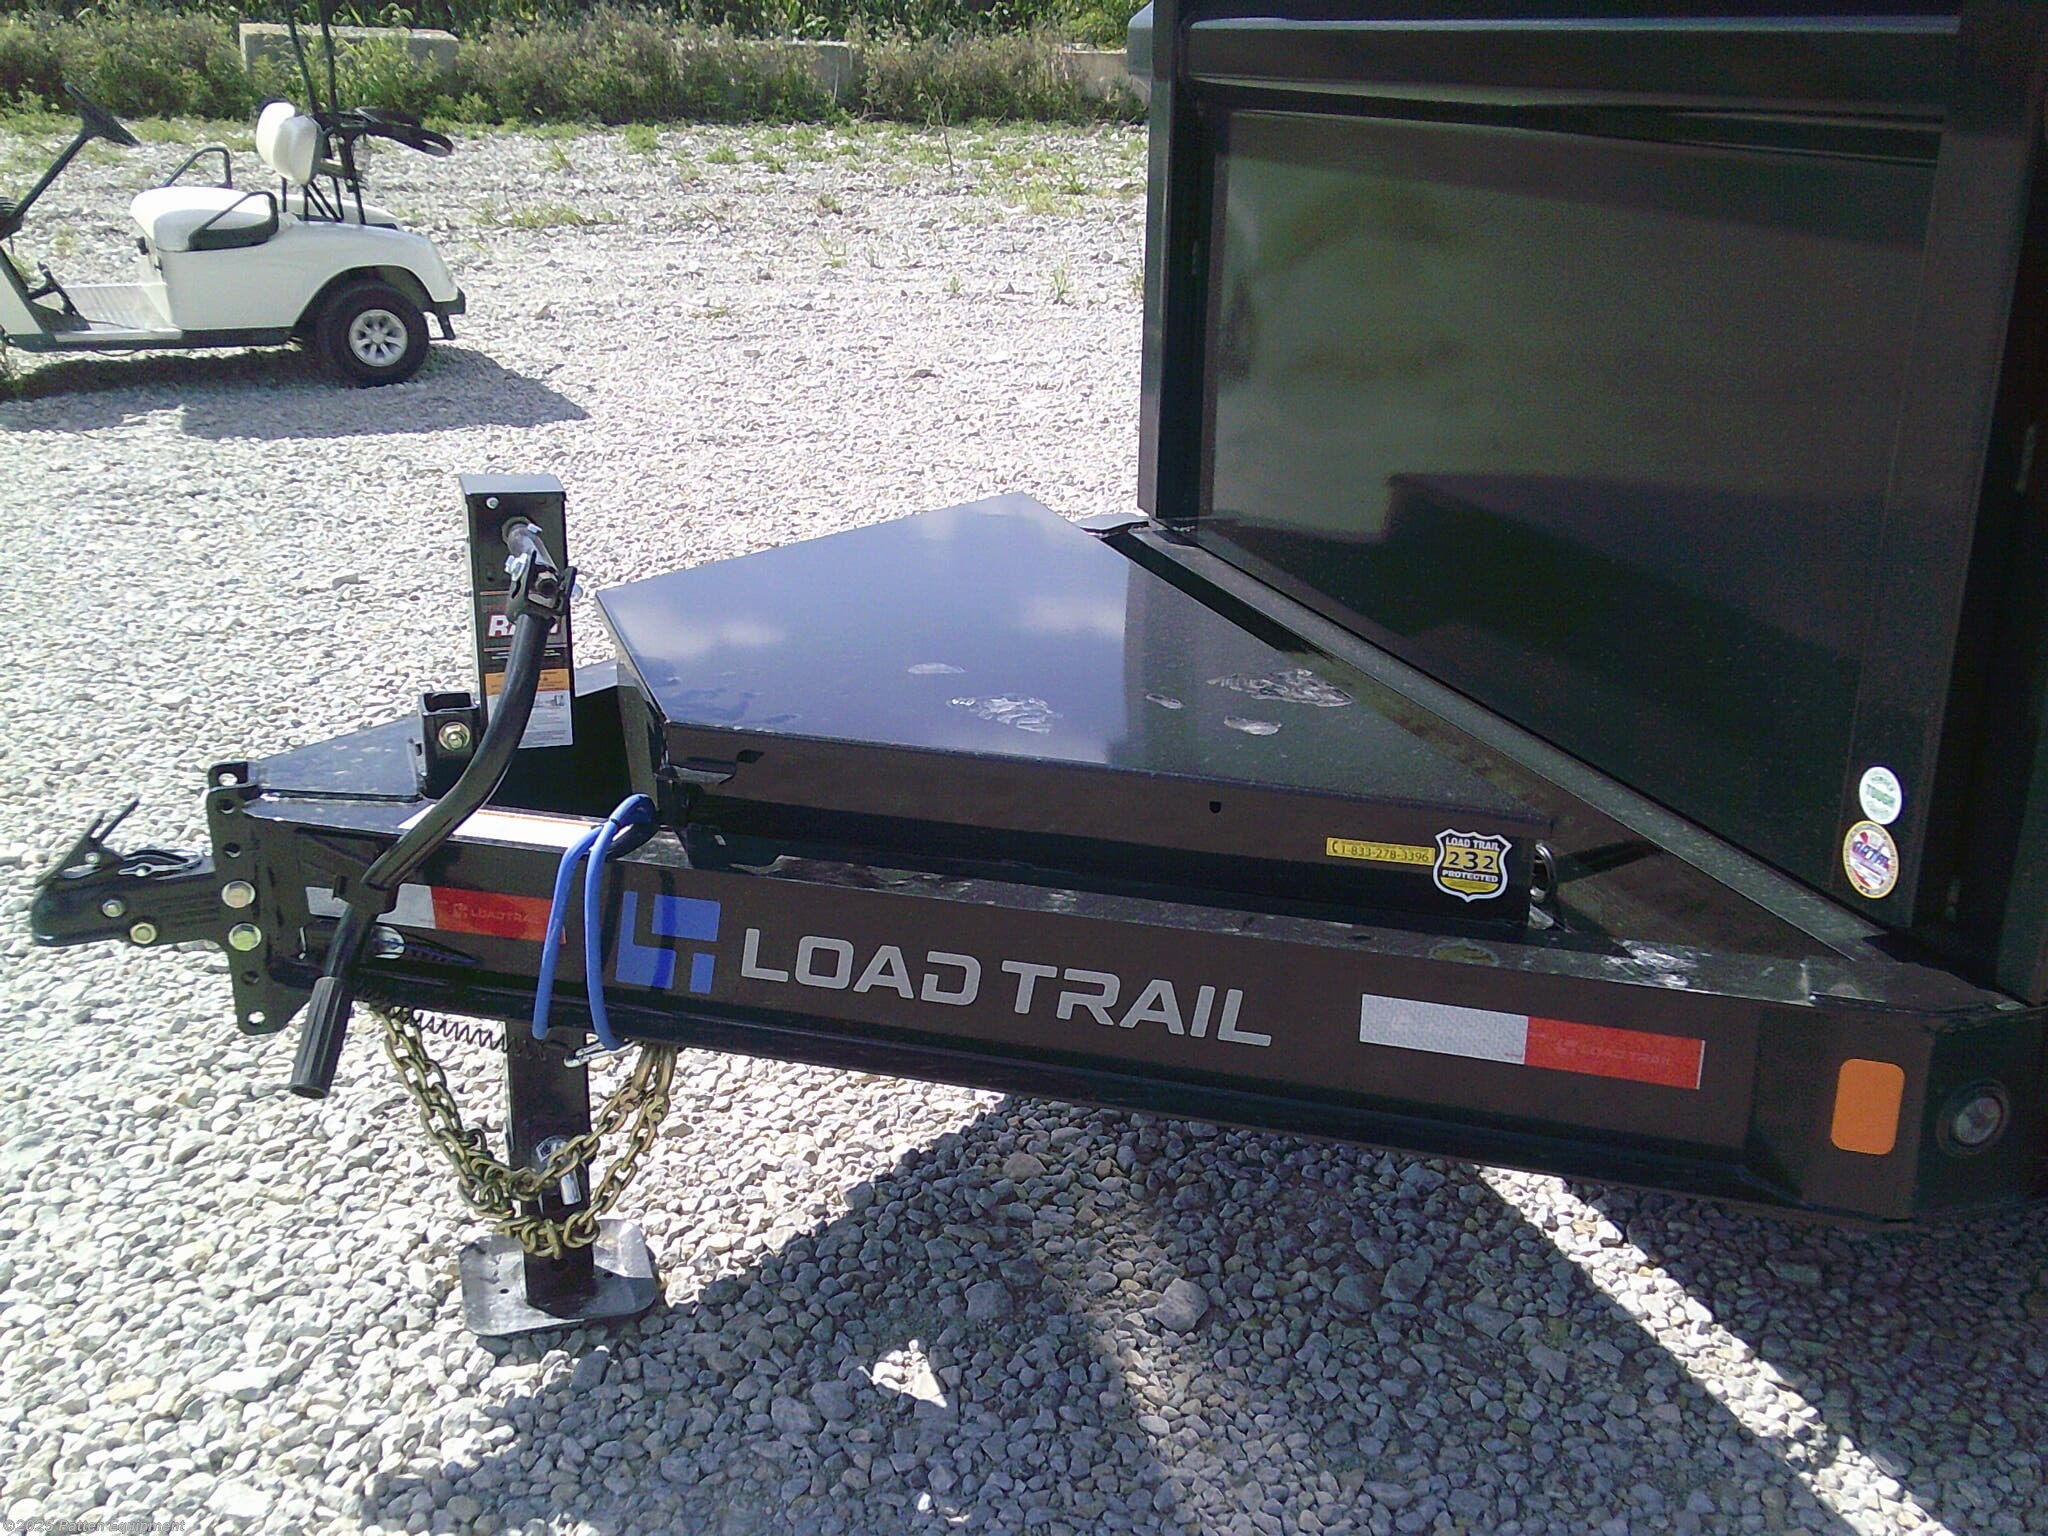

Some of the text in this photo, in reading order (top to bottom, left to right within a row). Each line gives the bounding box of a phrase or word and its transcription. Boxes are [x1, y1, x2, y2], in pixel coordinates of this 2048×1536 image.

[1445, 836, 1500, 851] LOAD TRAIL
[1342, 845, 1429, 861] 1-833-278-3396
[1448, 851, 1494, 870] 232
[1442, 869, 1499, 882] PROTECTED
[741, 927, 1272, 1047] LOAD TRAIL
